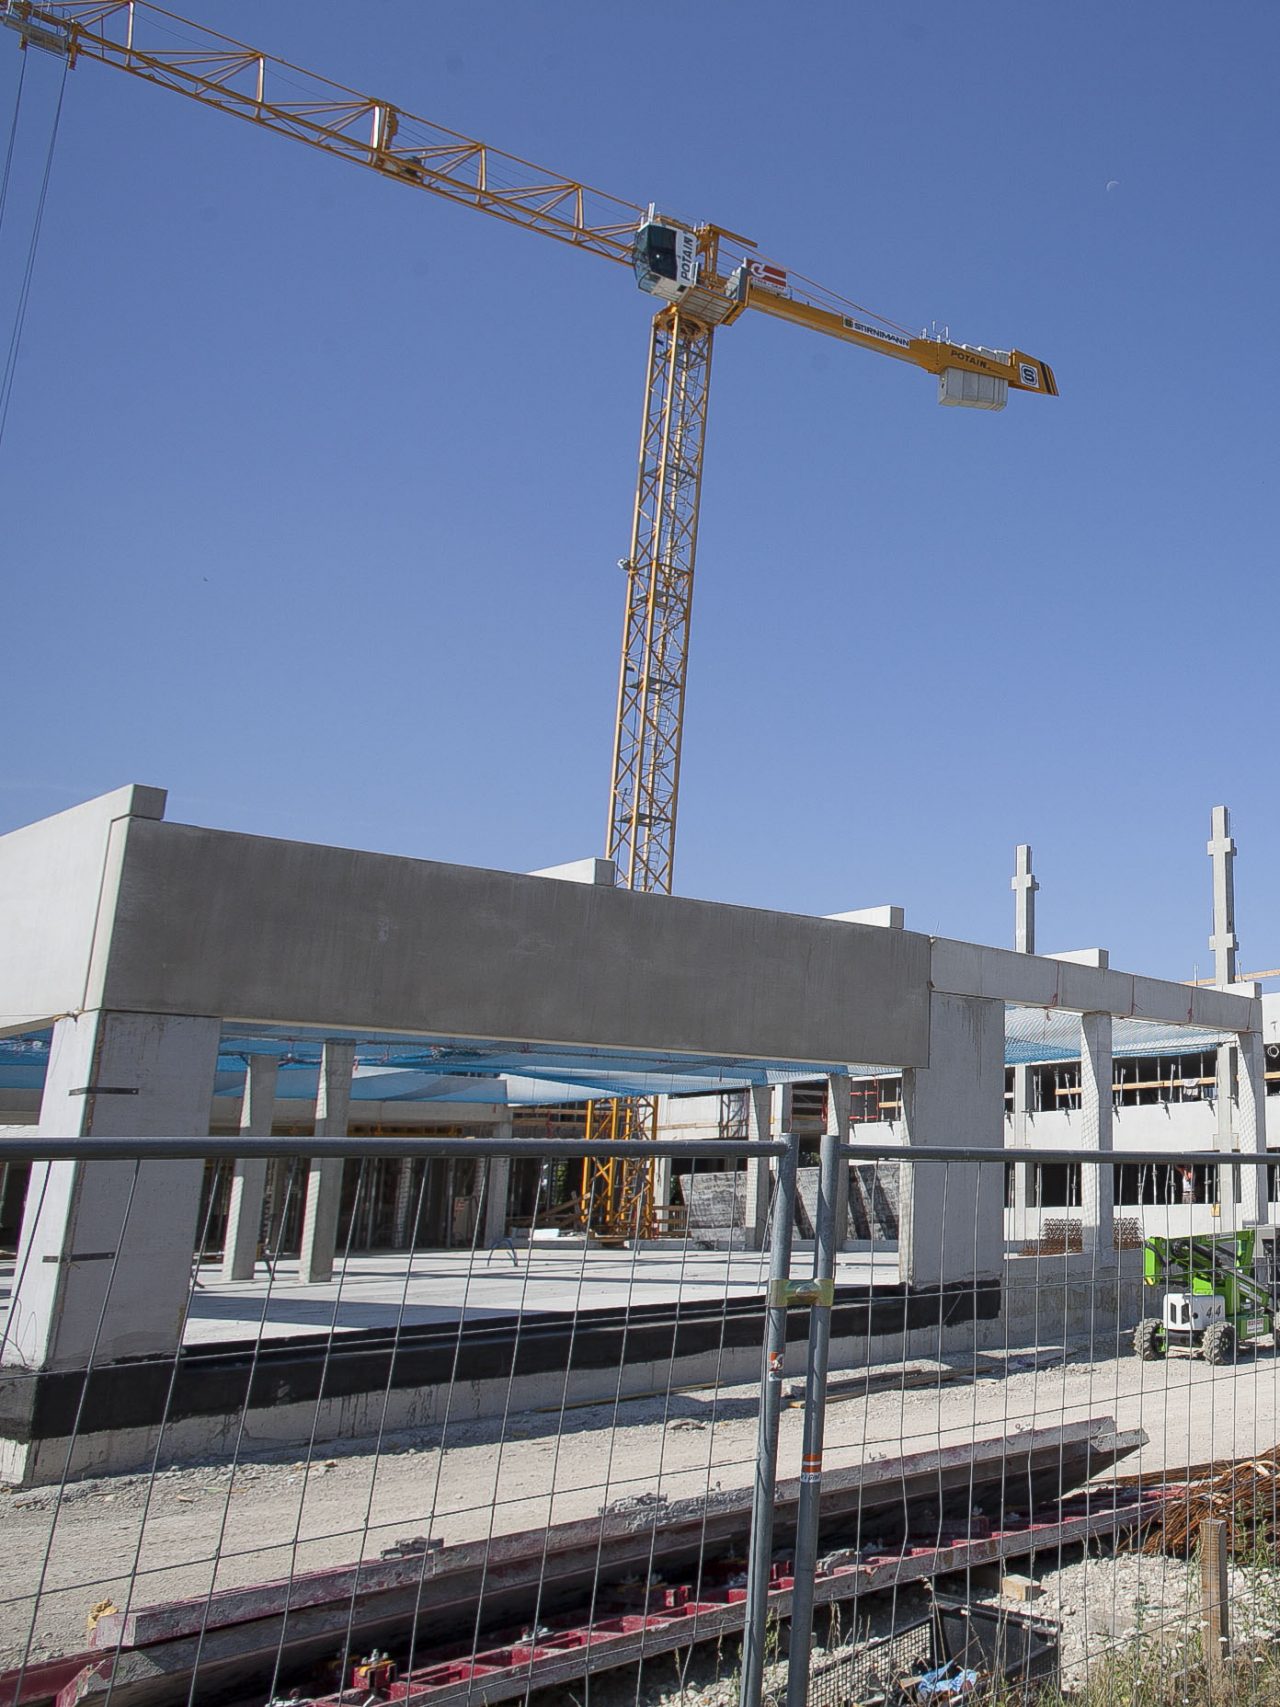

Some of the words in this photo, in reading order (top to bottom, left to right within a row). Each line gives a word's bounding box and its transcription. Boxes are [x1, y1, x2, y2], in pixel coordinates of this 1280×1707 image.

[680, 235, 694, 281] POTAIN
[854, 322, 909, 347] STIRNIMANN
[951, 349, 987, 368] POTAIN
[1023, 368, 1035, 382] S
